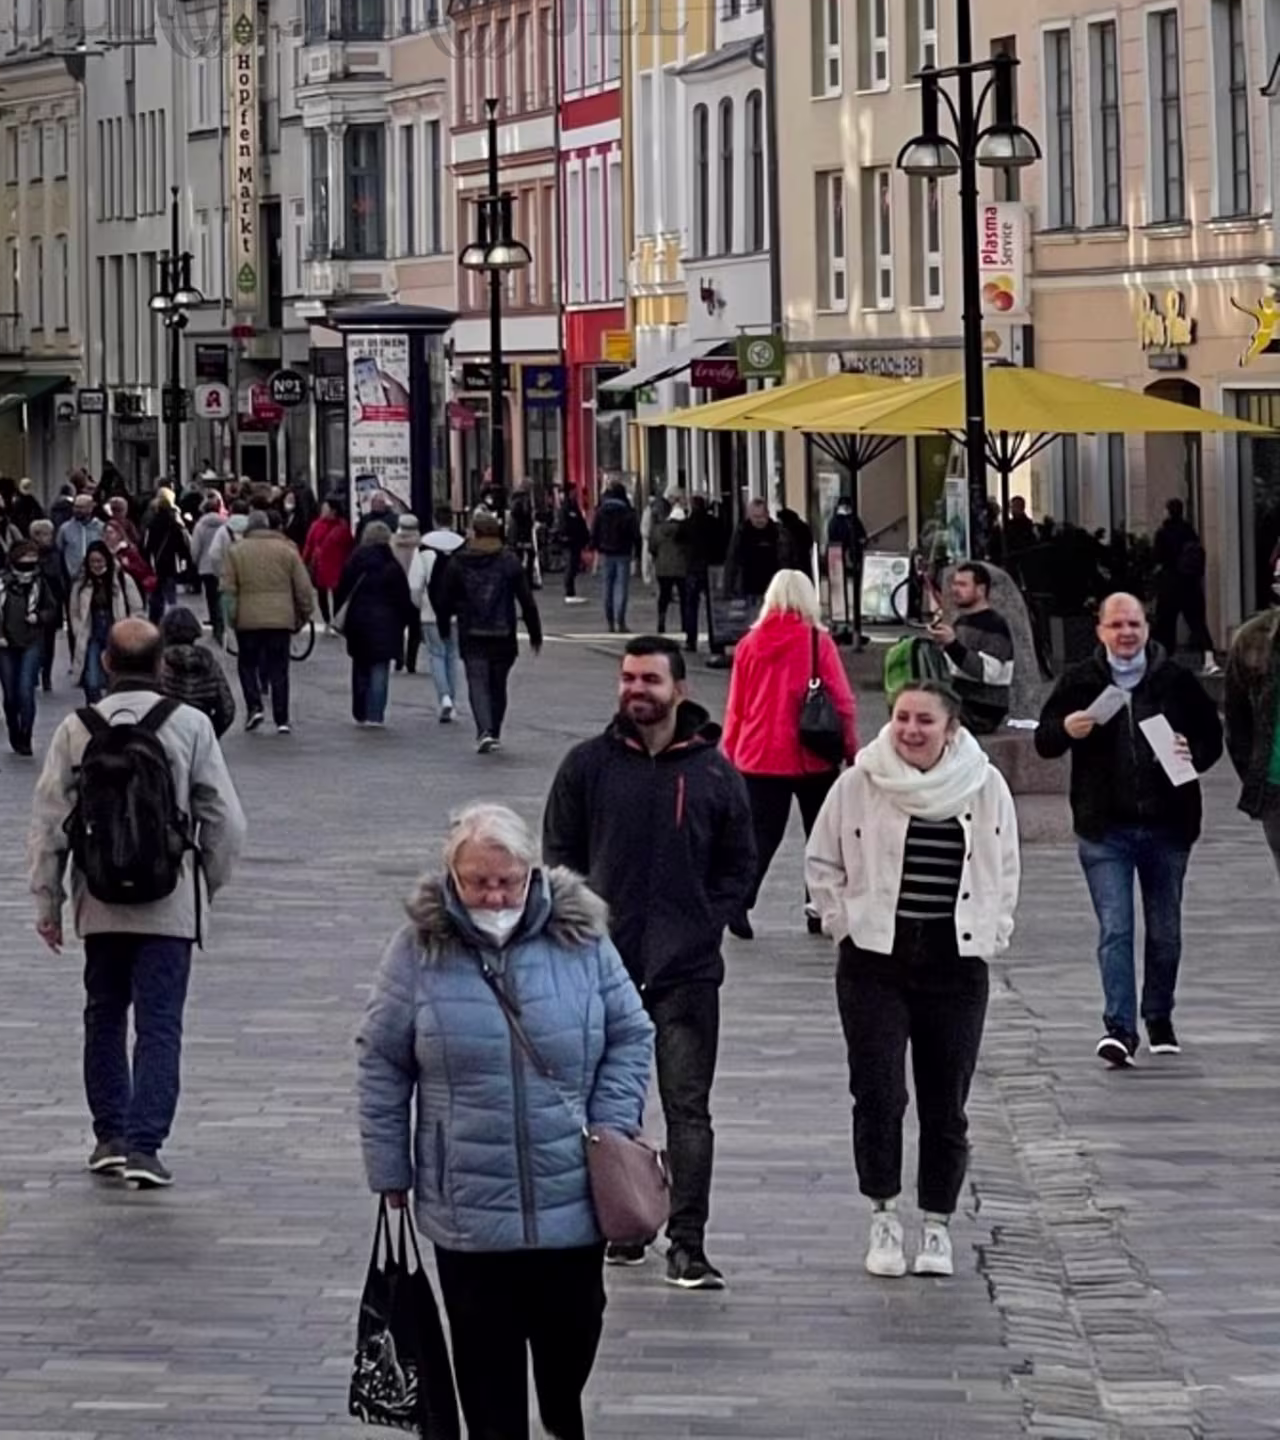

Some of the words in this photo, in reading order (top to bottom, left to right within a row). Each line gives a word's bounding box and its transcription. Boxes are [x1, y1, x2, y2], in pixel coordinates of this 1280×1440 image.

[237, 54, 252, 158] Hopfen
[237, 166, 253, 253] Markt
[981, 206, 999, 265] Plasma
[1000, 221, 1014, 266] Service
